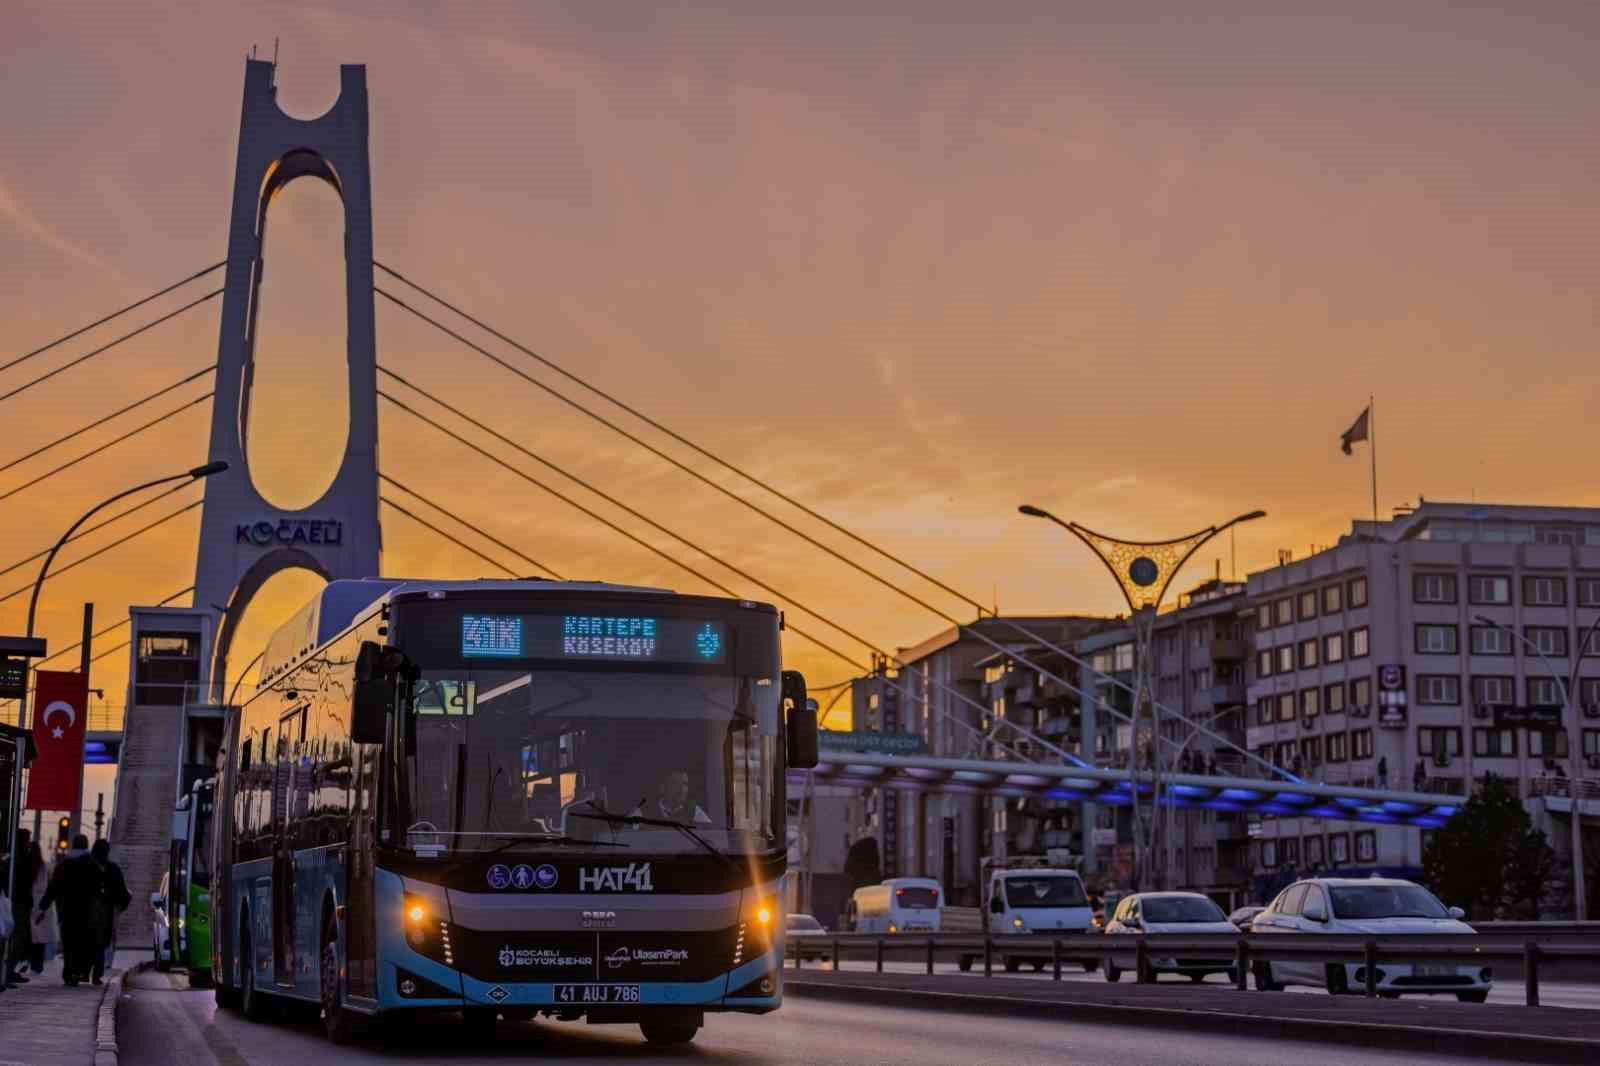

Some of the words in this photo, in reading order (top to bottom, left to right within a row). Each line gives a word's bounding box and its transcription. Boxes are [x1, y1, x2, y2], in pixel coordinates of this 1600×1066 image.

[564, 616, 656, 636] KARTEPE
[560, 986, 575, 1001] 41
[583, 986, 608, 1001] AUJ
[614, 986, 639, 1001] 786
